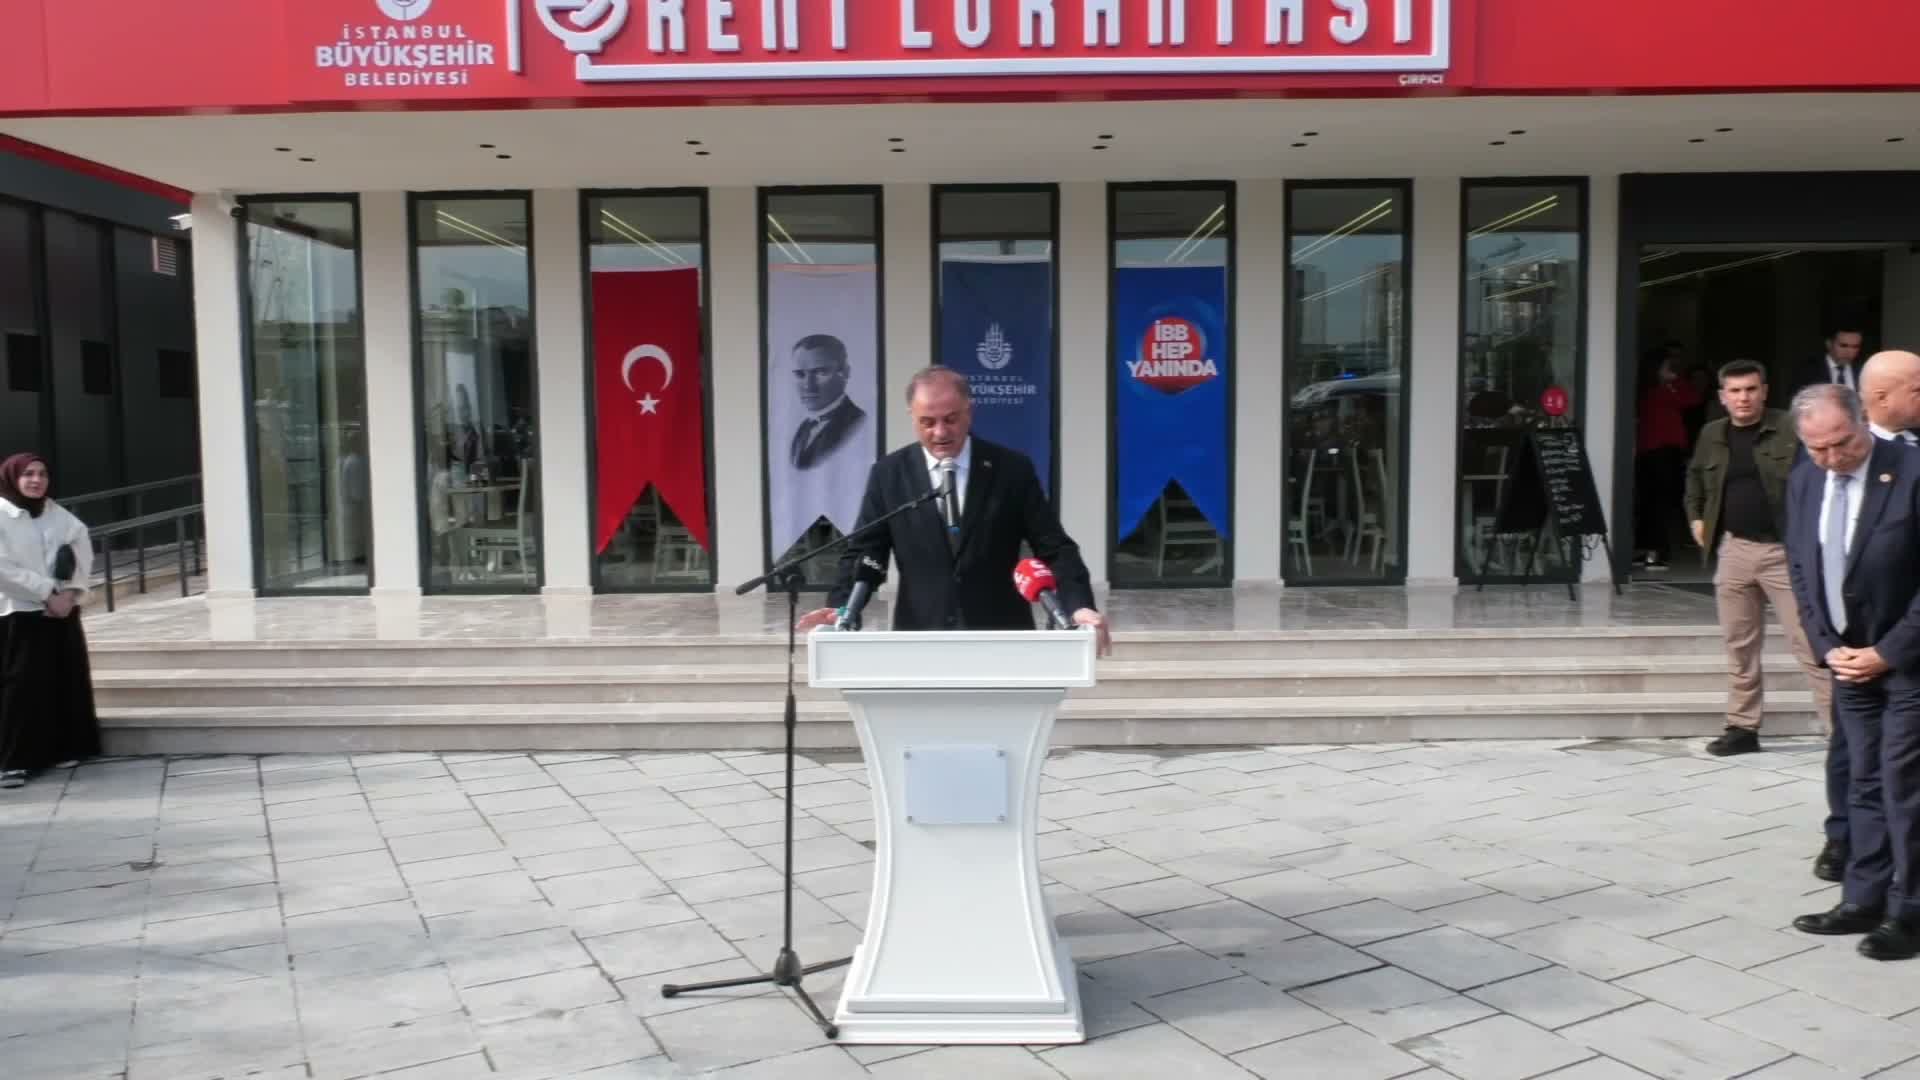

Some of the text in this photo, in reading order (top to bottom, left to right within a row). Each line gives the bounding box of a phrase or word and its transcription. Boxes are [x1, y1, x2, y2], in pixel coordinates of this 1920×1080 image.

[343, 24, 466, 39] İSTANBUL
[316, 40, 494, 68] BÜYÜKŞEHİR
[345, 69, 468, 86] BELEDİYESİ
[1155, 320, 1188, 341] İBB
[1152, 342, 1192, 359] HEP
[1126, 359, 1218, 377] YANINDA
